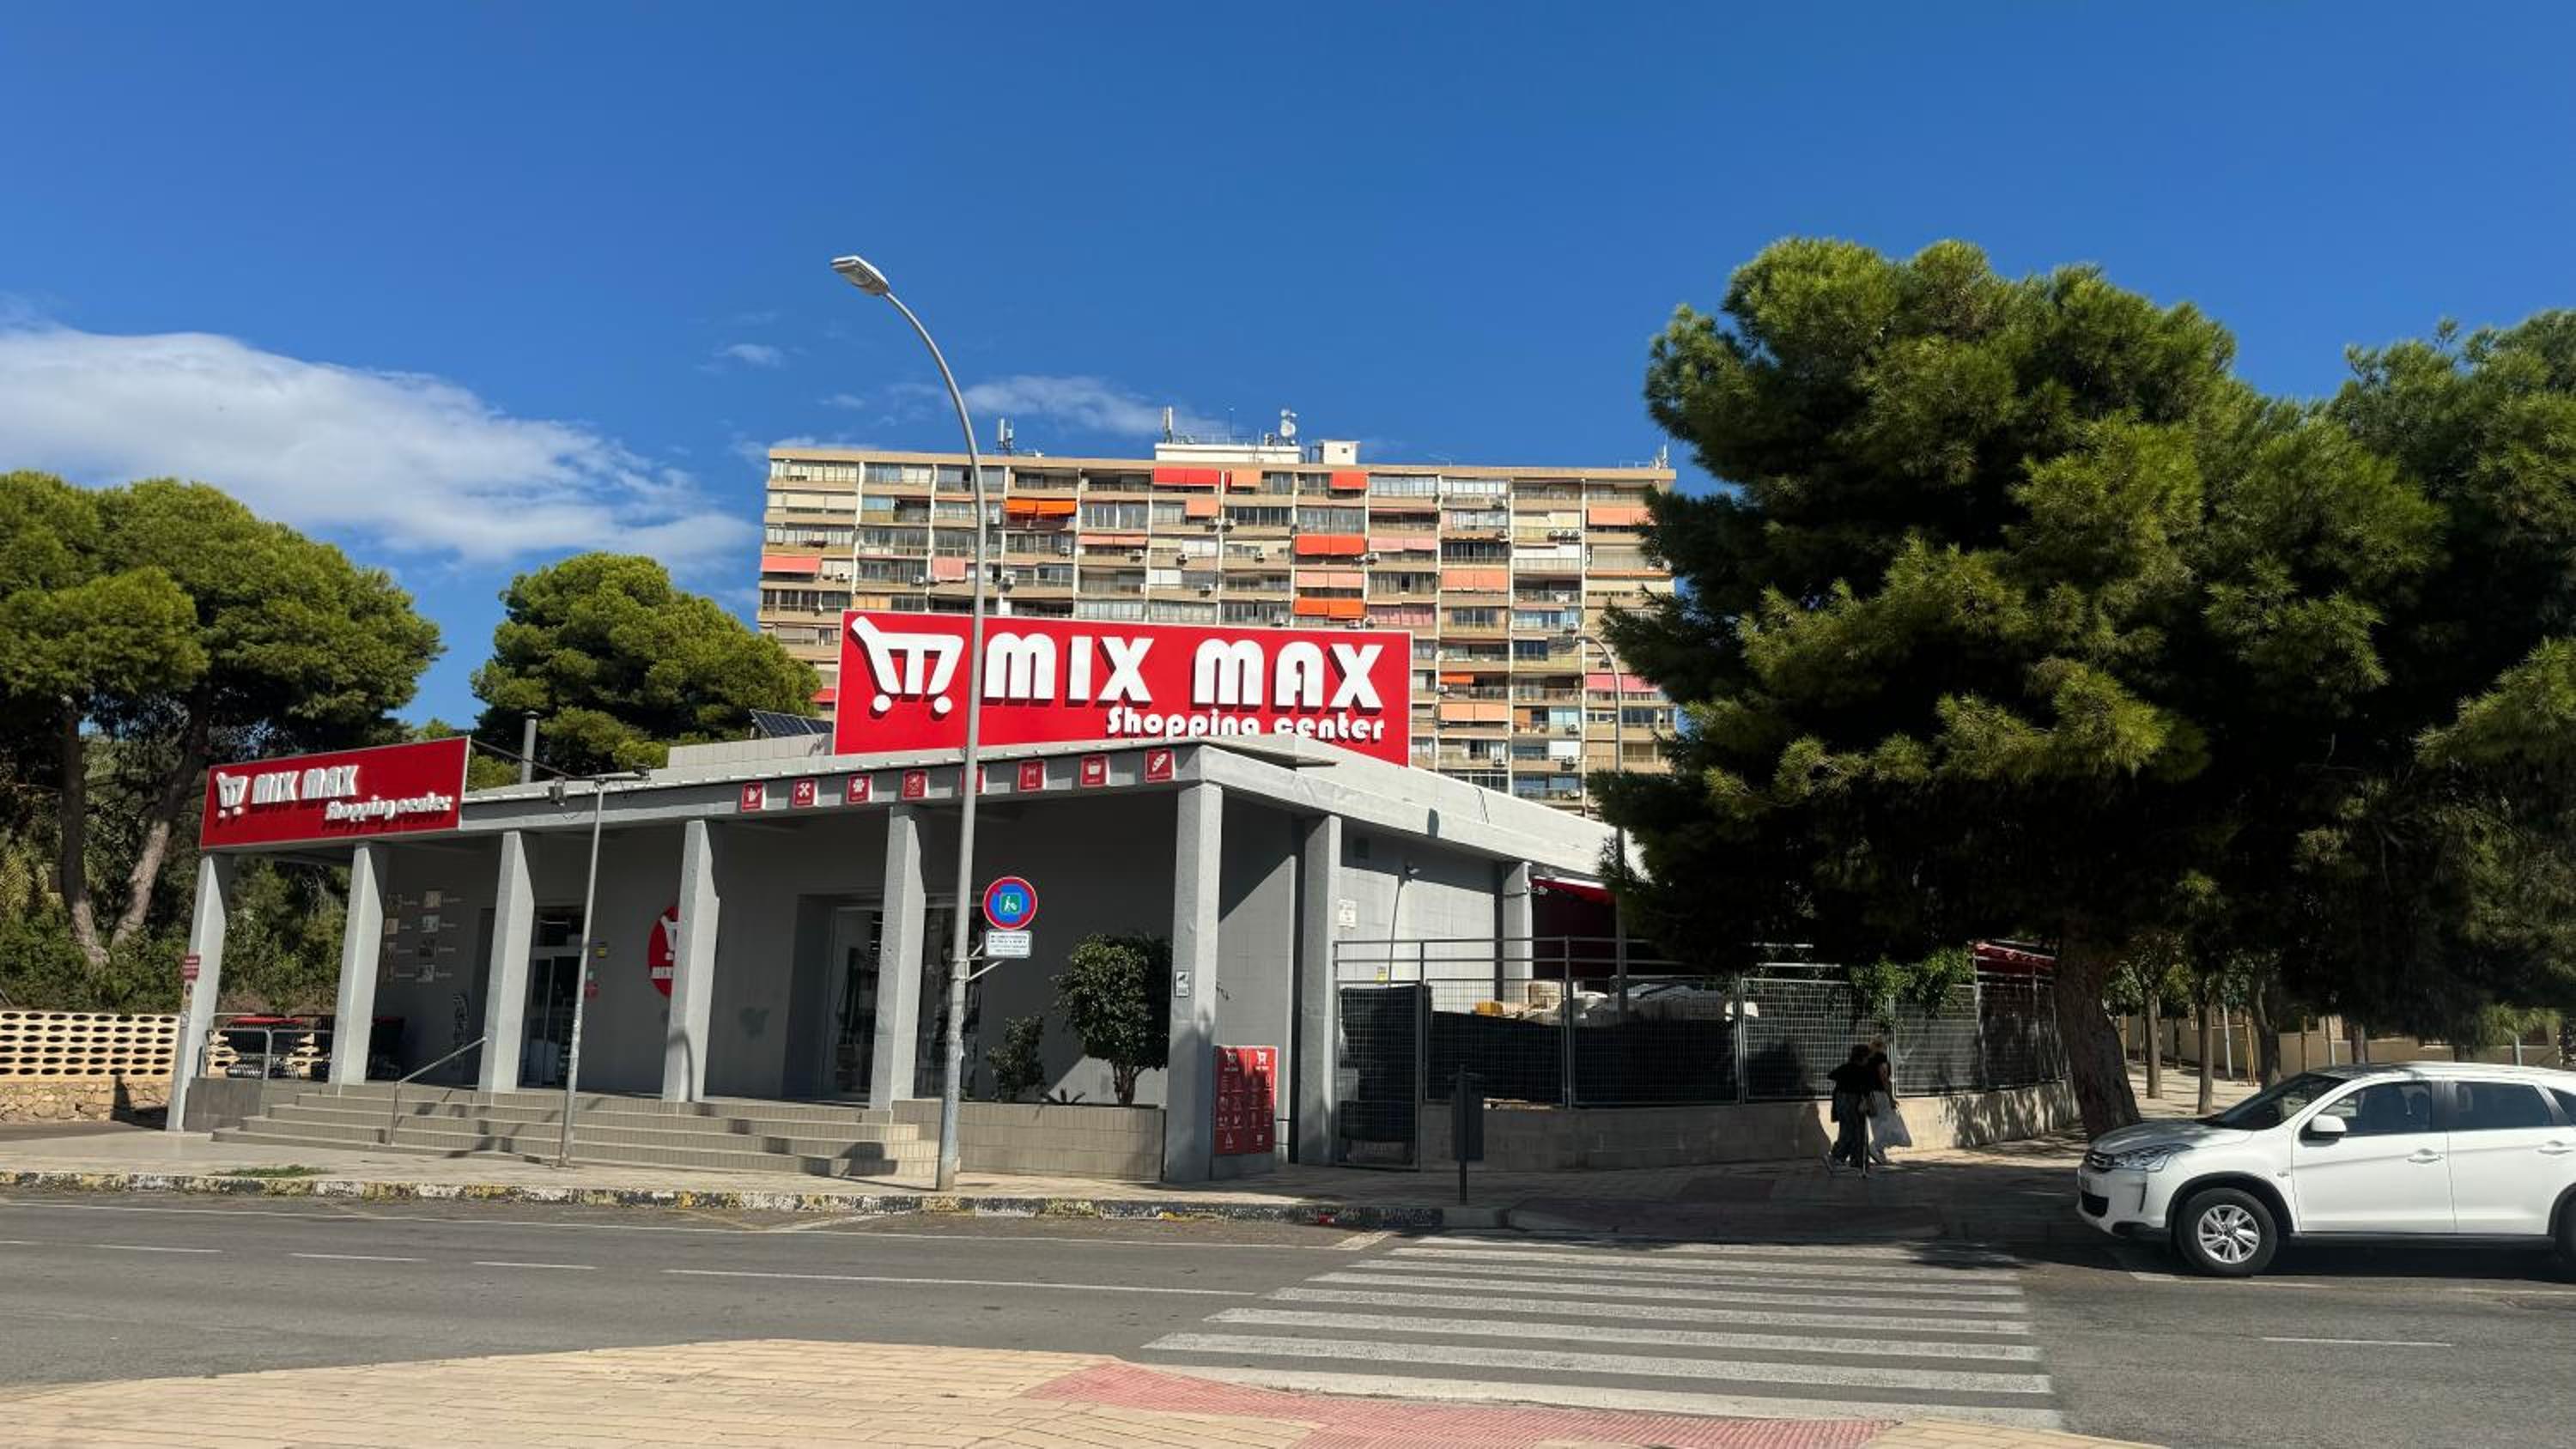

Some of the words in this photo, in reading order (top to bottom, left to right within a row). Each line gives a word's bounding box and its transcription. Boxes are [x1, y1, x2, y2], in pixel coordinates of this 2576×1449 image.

[983, 632, 1154, 702] MIX
[1195, 638, 1383, 708] MAX
[1107, 707, 1260, 737] Shopping
[1273, 712, 1385, 739] center
[252, 771, 300, 804] MIX
[301, 765, 359, 799] MAX
[325, 795, 395, 821] Shopping
[395, 791, 453, 814] center
